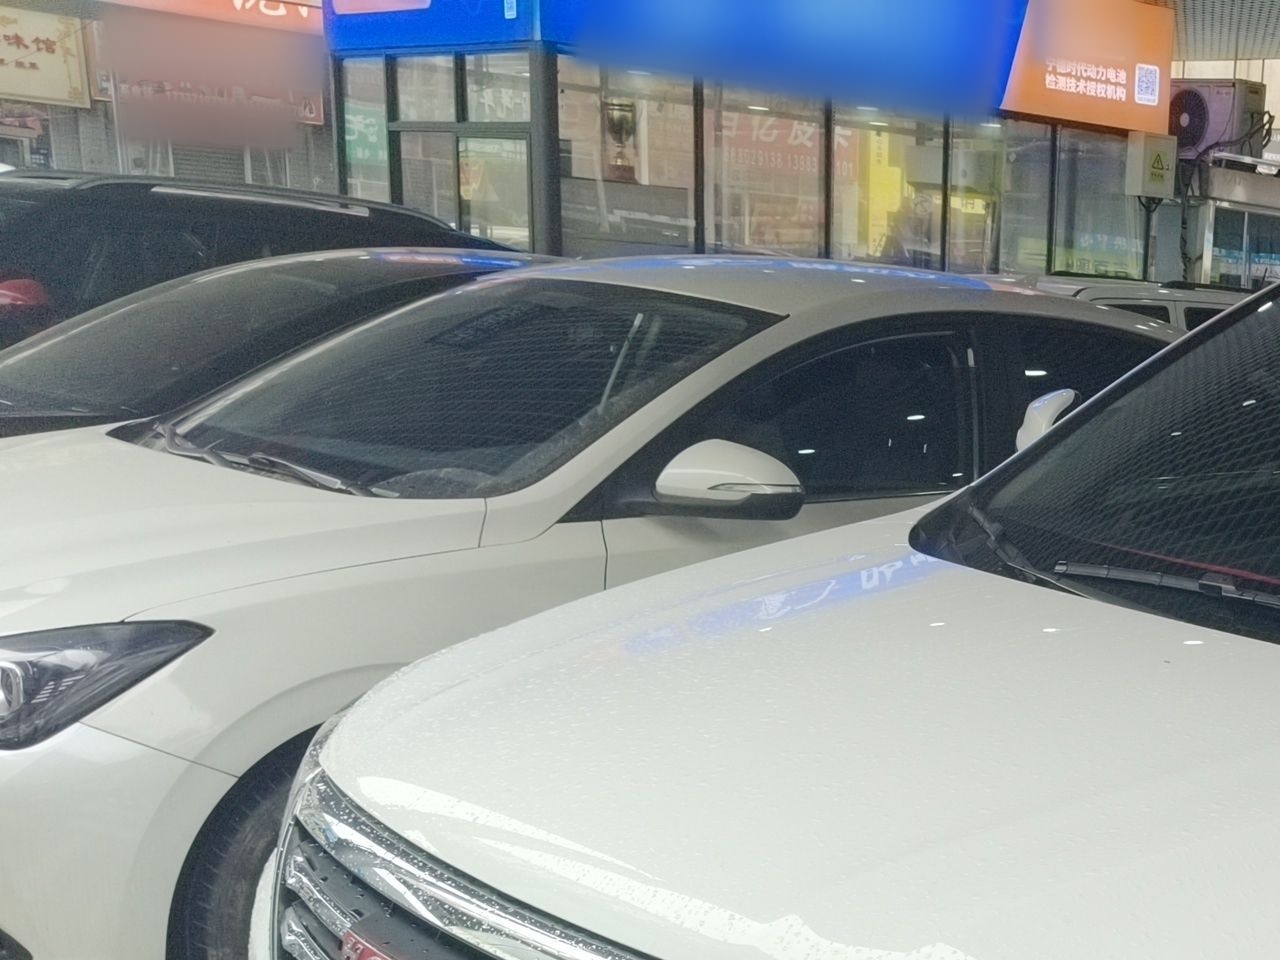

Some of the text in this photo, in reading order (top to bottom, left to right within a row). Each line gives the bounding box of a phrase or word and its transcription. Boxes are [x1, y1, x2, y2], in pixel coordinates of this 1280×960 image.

[1045, 73, 1127, 102] 检测技术授权机构
